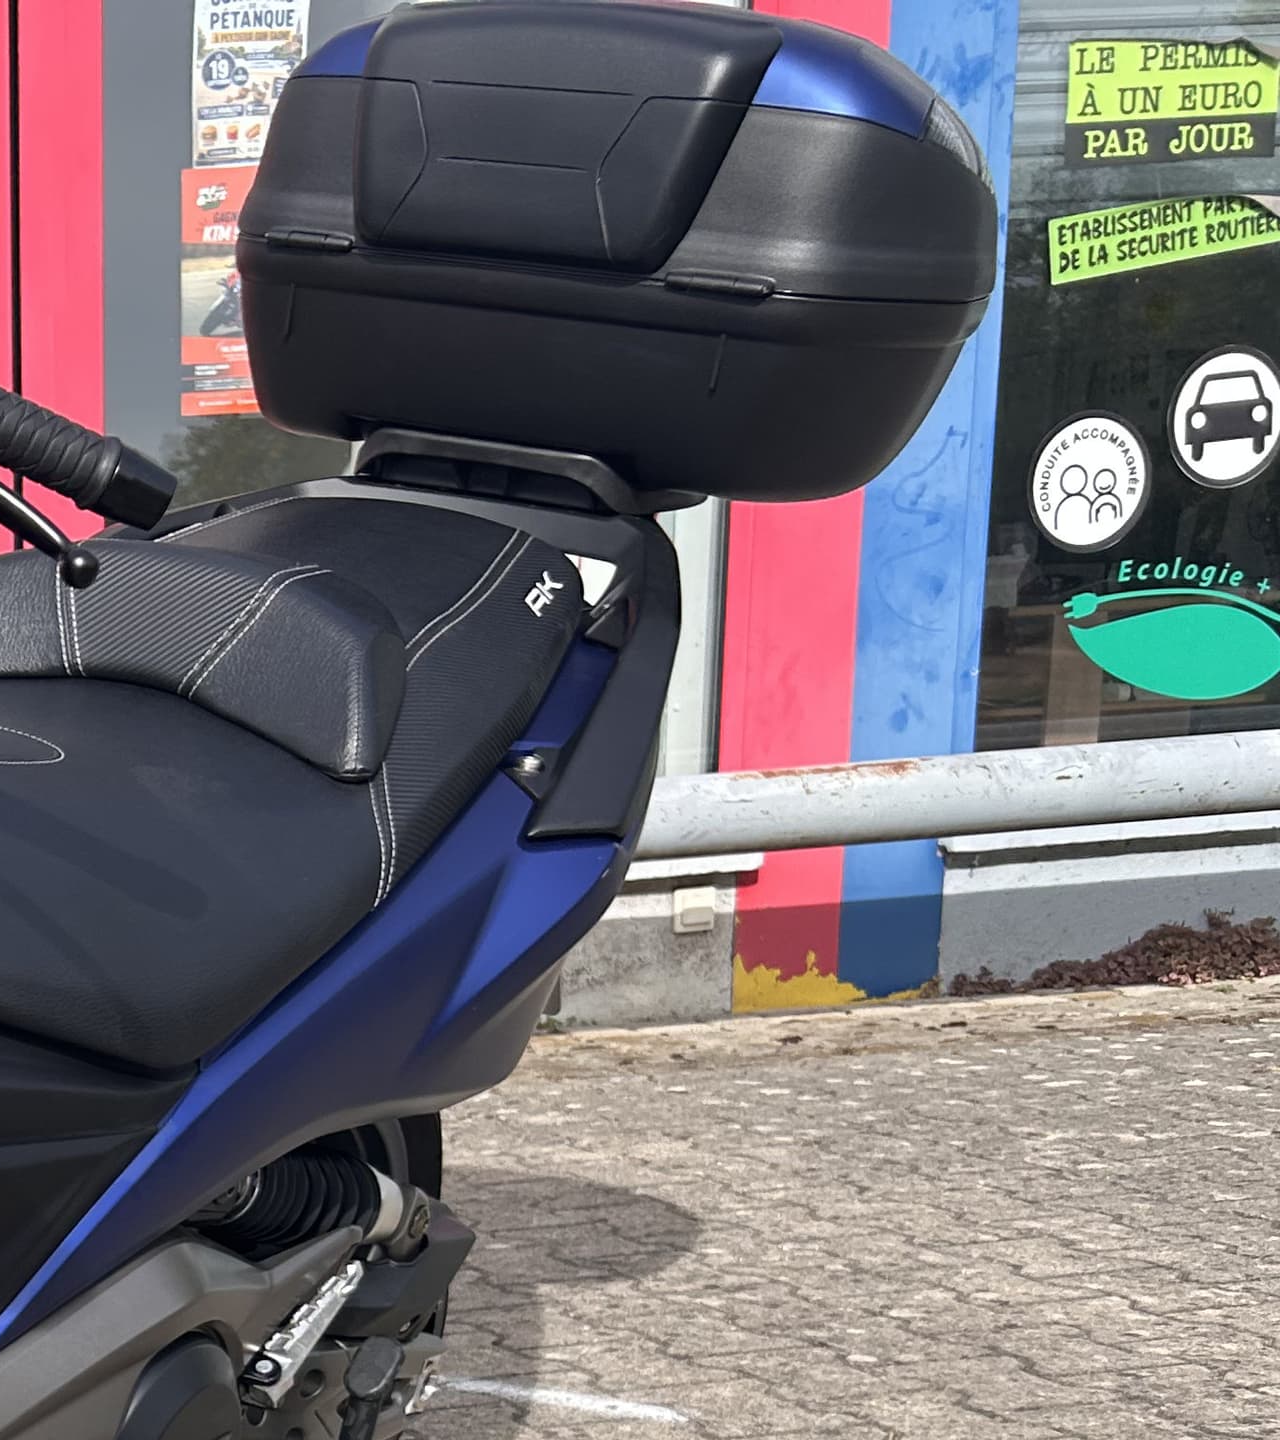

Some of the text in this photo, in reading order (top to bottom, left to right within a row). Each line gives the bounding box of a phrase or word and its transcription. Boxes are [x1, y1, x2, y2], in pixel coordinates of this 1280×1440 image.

[210, 8, 295, 29] PÉTANQUE
[209, 59, 229, 80] 19
[1075, 43, 1260, 76] LE PERMIS
[1077, 80, 1263, 117] À UN EURO
[1083, 122, 1254, 159] PAR JOUR
[1057, 200, 1196, 247] ETABLISSEMENT
[1058, 248, 1081, 274] DE
[1088, 243, 1109, 267] LA
[1117, 225, 1198, 262] SECURITE
[1039, 428, 1138, 512] CONDUITE ACCOMPAGNÉE
[1117, 556, 1245, 587] Ecologie
